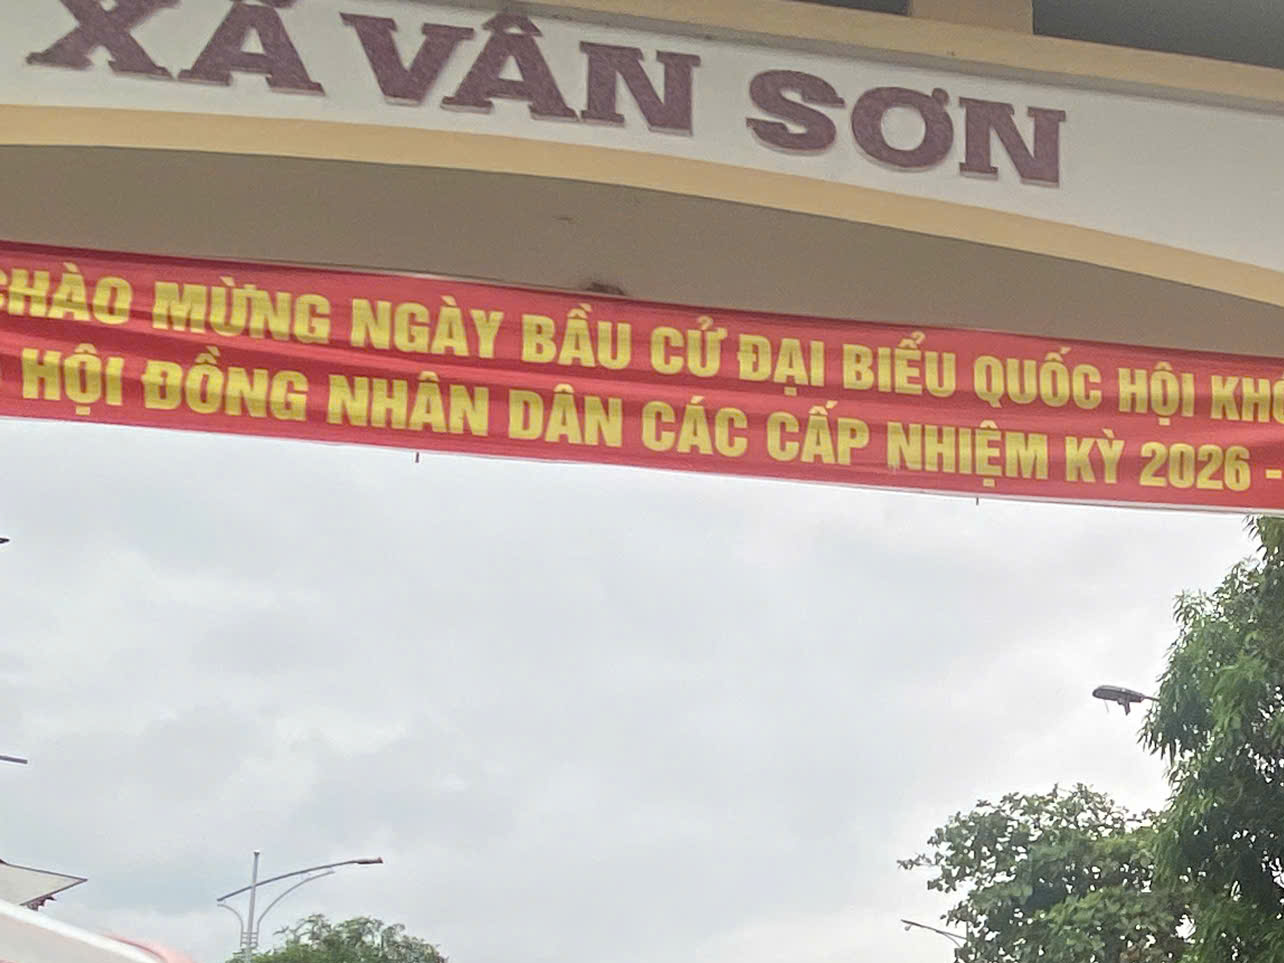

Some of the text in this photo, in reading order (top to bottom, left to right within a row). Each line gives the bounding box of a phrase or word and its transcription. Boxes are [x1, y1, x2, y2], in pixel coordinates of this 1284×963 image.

[26, 0, 1067, 187] XÃ VÂN SƠN
[0, 262, 133, 324] HÀO
[152, 277, 331, 345] MỪNG
[350, 296, 504, 359] NGÀY
[521, 303, 631, 370] BẦU
[650, 316, 728, 377] CỬ
[737, 334, 825, 397] ĐẠI
[842, 332, 957, 398] BIỂU
[973, 346, 1102, 410] QUỐC
[1117, 361, 1195, 427] HỘI
[22, 343, 125, 416] HỘI
[141, 346, 309, 421] ĐỒNG
[327, 371, 489, 437] NHÂN
[508, 383, 623, 447] DÂN
[641, 395, 749, 458] CÁC
[766, 400, 870, 466] CẤP
[887, 420, 1048, 487] NHIỆM
[1065, 429, 1126, 484] KỲ
[1139, 443, 1251, 492] 2026
